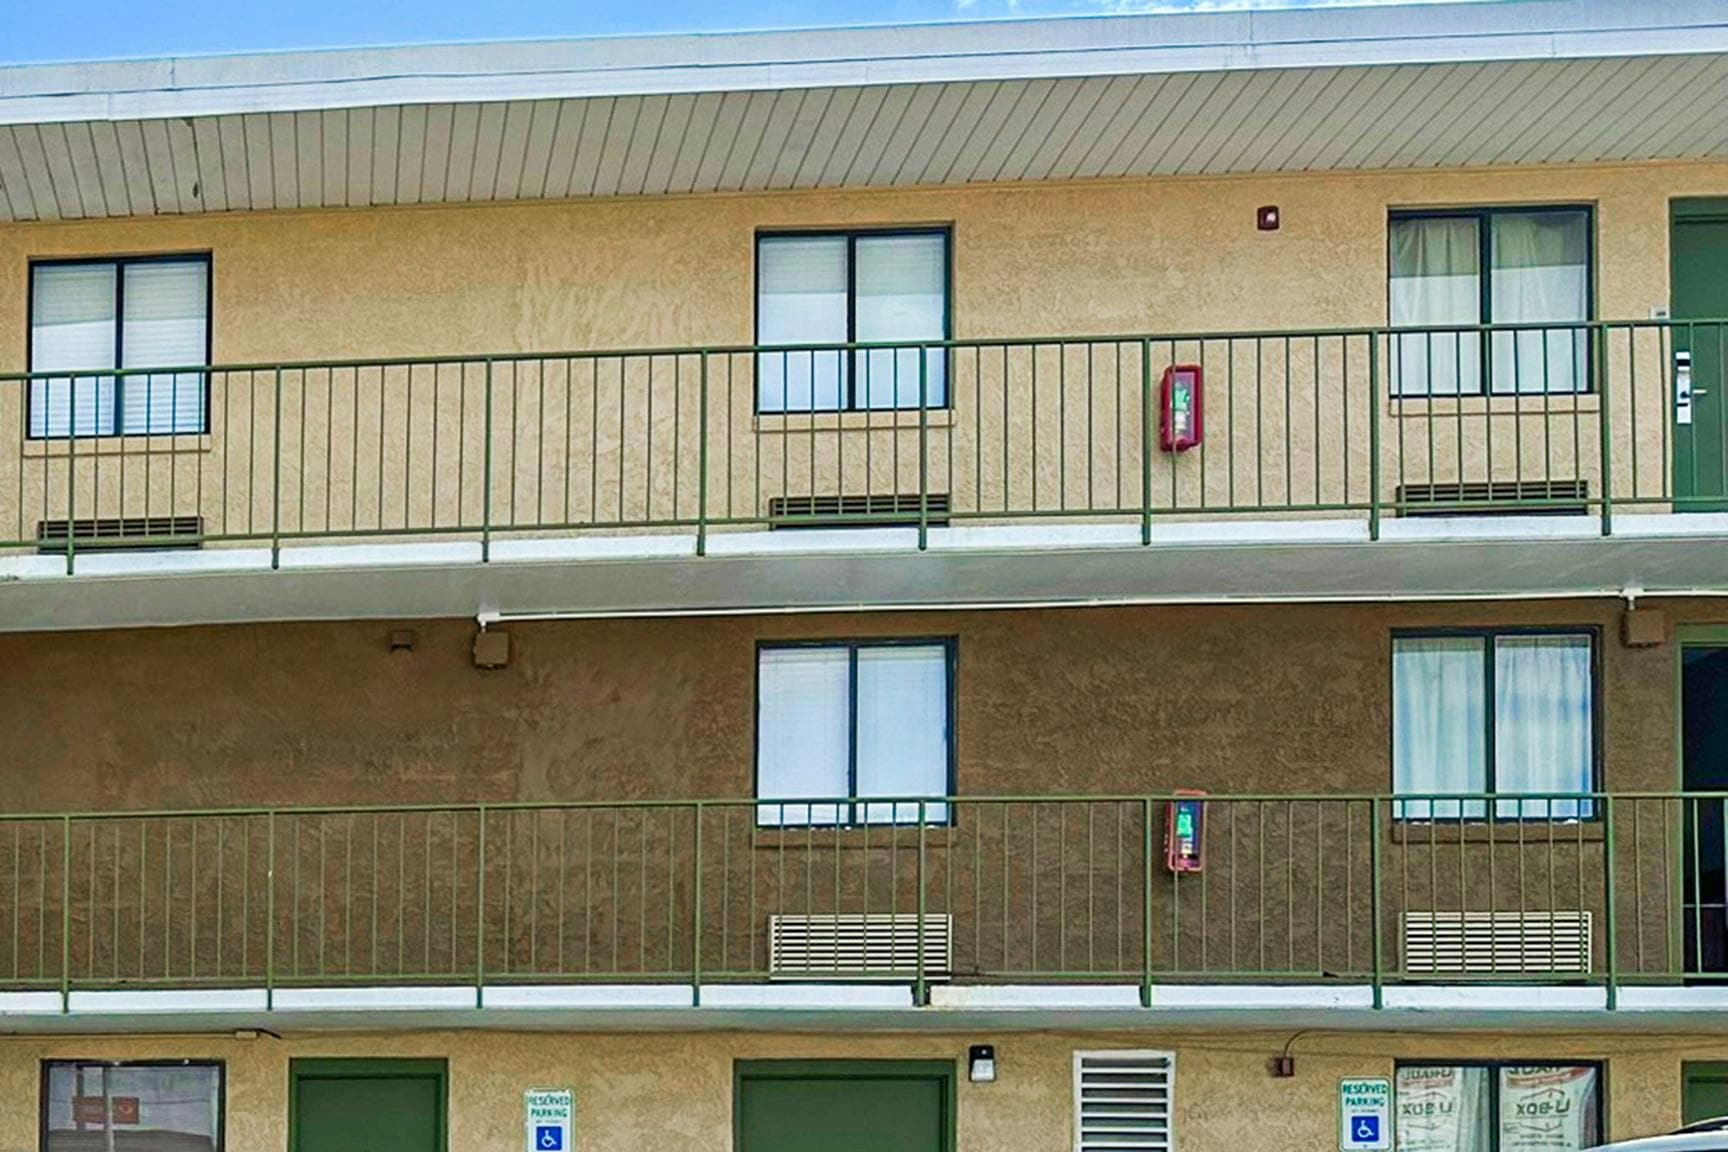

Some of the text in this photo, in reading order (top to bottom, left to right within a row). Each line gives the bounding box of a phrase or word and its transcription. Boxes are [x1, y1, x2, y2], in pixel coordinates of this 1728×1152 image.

[1343, 1083, 1387, 1094] RESERVED
[528, 1095, 570, 1106] RESERVED
[1346, 1096, 1385, 1107] PARKING
[531, 1107, 568, 1118] PARKING
